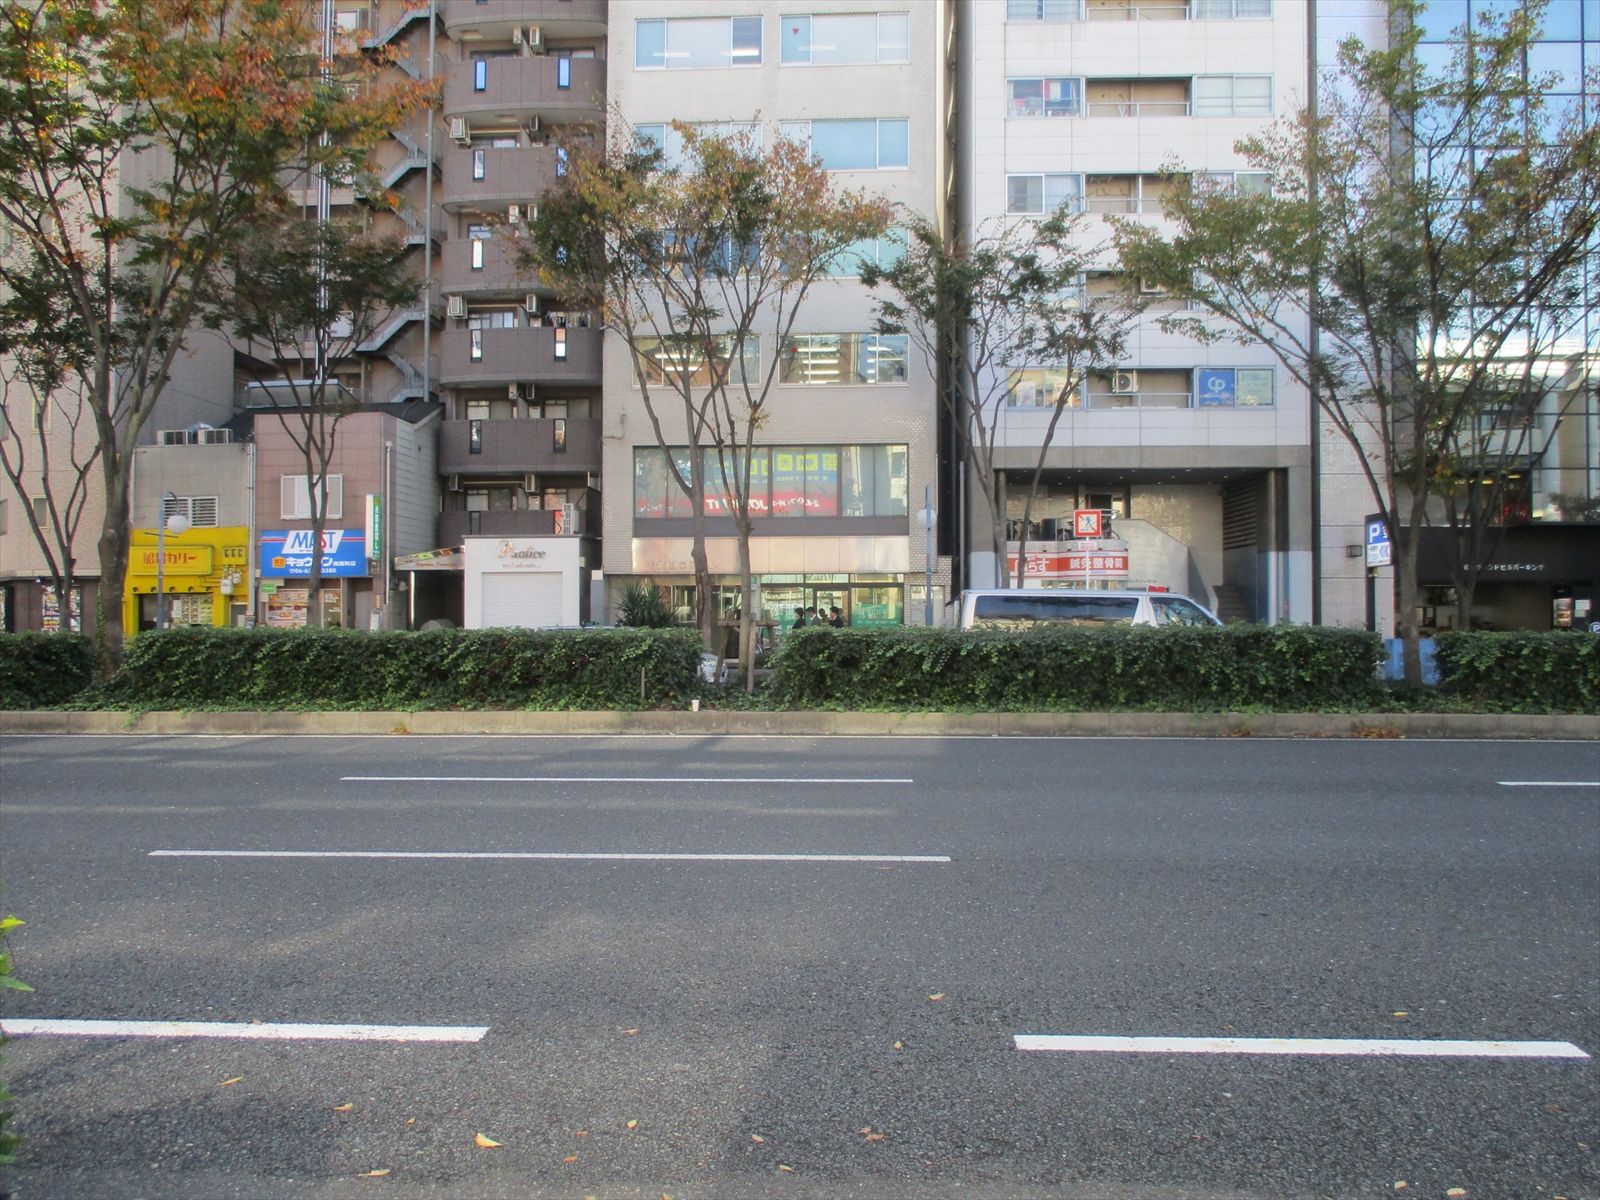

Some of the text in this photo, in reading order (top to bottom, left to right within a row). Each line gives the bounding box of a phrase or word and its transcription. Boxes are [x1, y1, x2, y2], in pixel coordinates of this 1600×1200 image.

[1369, 523, 1380, 543] P
[286, 556, 333, 567] キョウン
